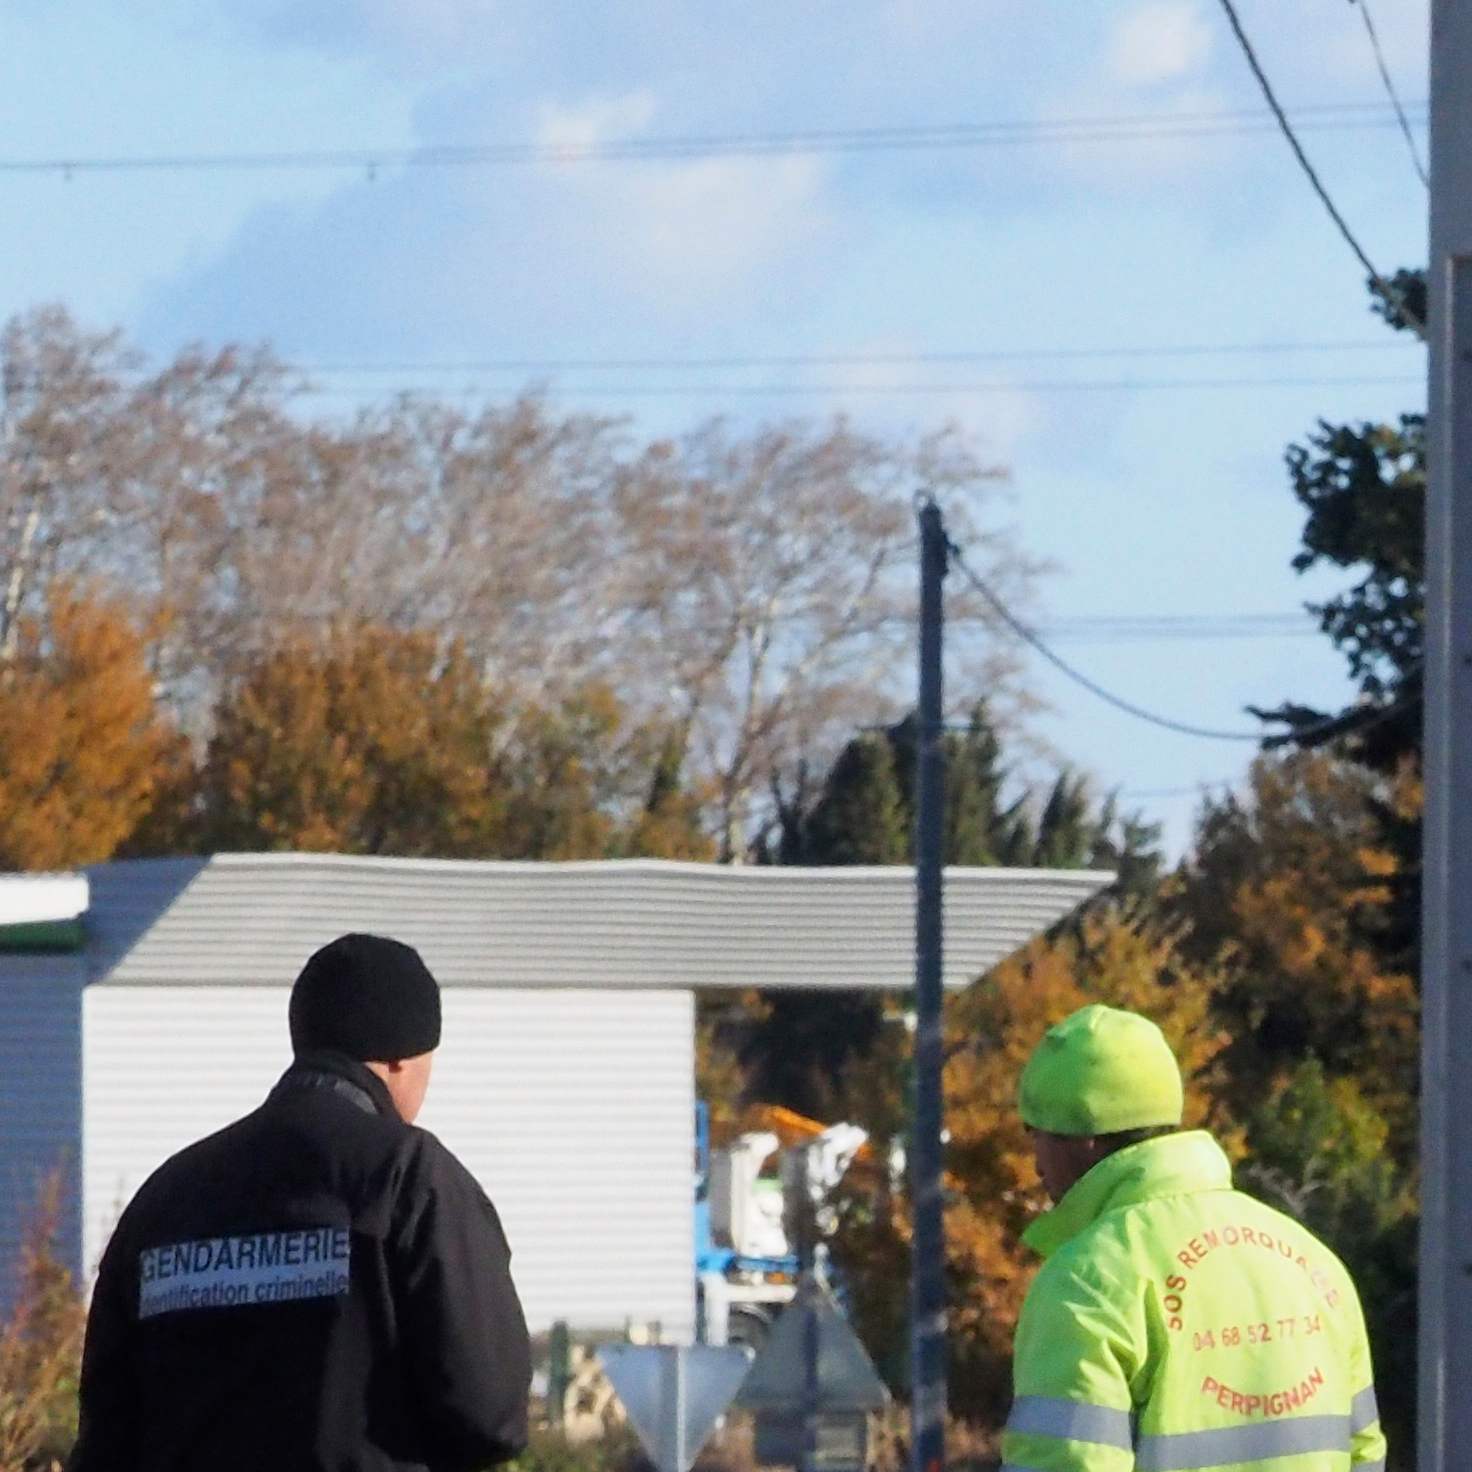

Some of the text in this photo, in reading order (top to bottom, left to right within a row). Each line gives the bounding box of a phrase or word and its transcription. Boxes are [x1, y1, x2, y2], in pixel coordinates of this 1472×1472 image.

[142, 1228, 349, 1283] GENDARMERIE
[1222, 1326, 1241, 1347] 68
[1247, 1322, 1272, 1344] 52
[1277, 1318, 1296, 1337] 77
[1201, 1365, 1325, 1417] PERPIGNAN
